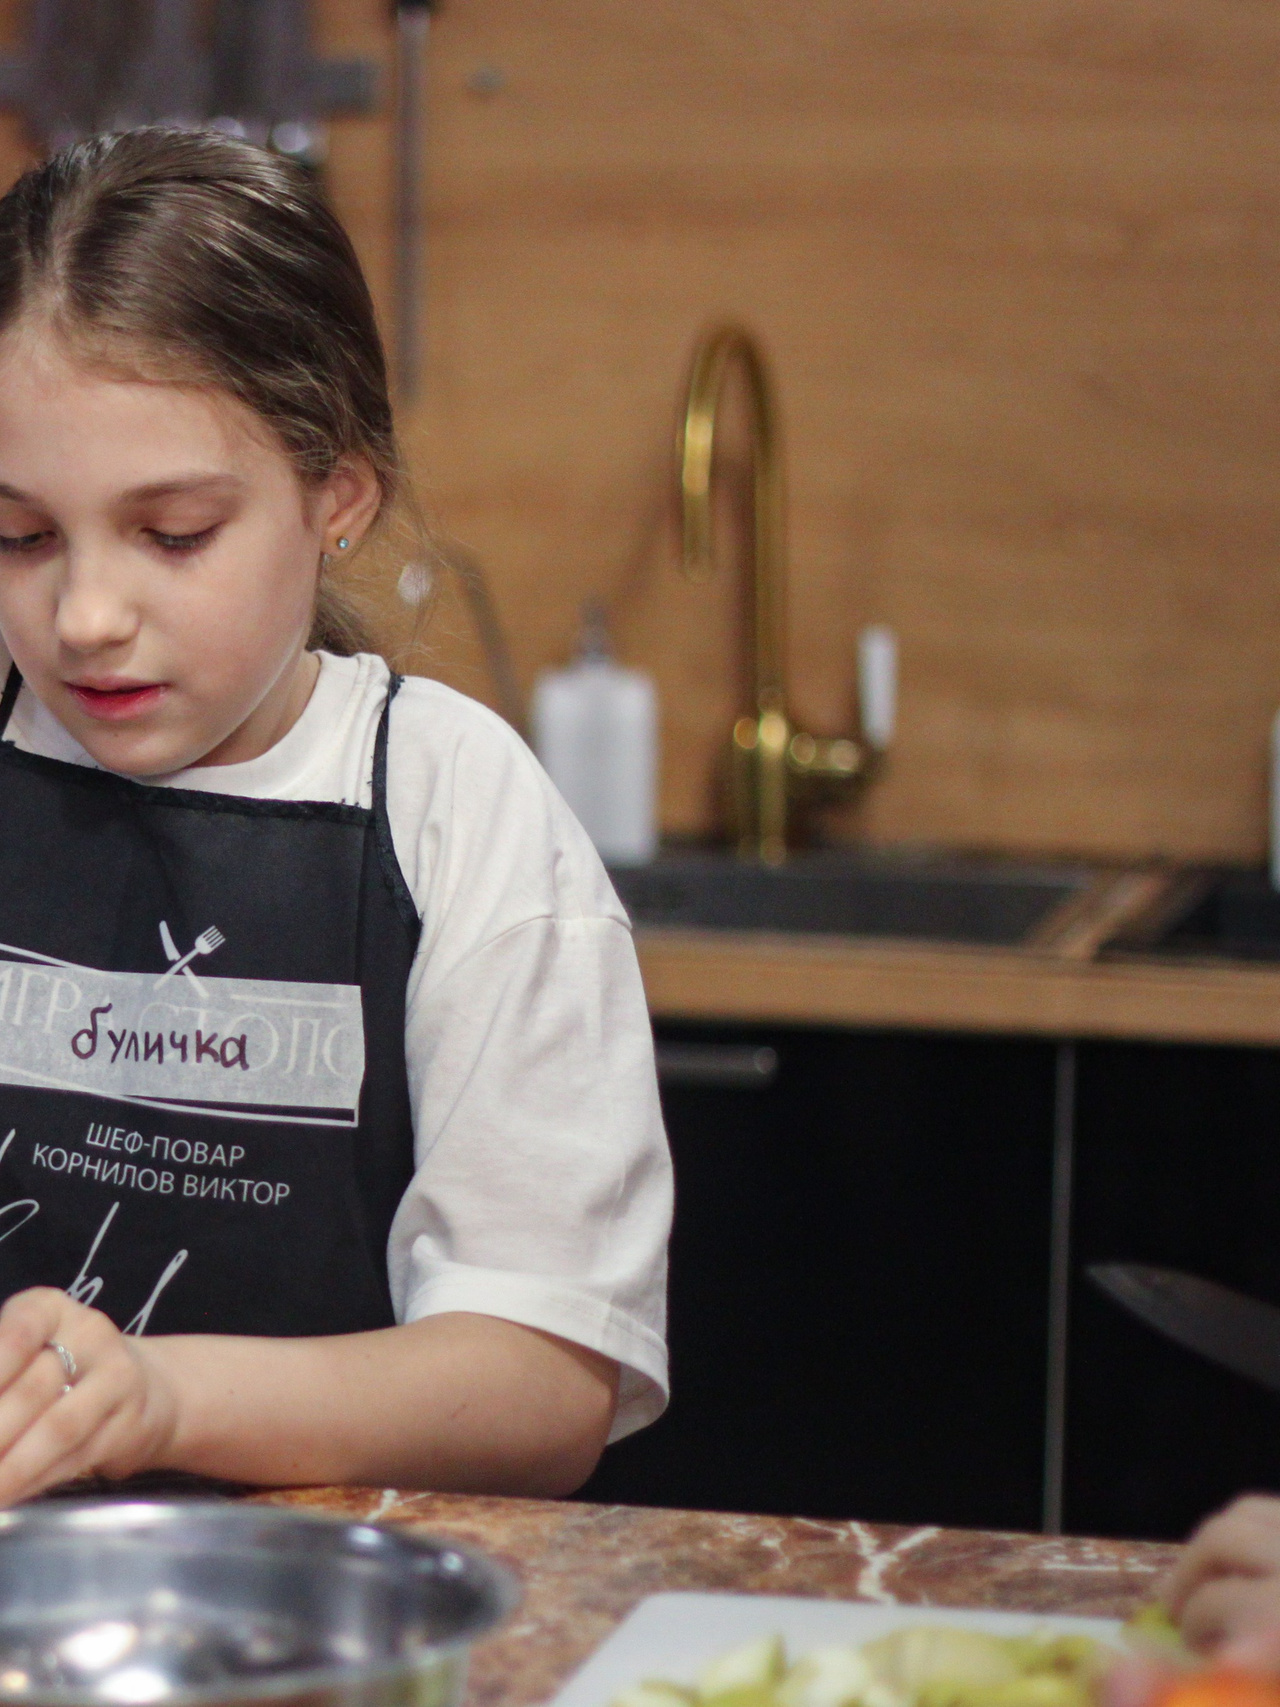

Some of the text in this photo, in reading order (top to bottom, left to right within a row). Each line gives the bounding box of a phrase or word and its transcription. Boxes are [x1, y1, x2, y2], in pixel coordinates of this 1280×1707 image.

[71, 1002, 250, 1071] буличка
[32, 1143, 291, 1206] КОРНИЛОВ ВИКТОР
[85, 1122, 246, 1167] ШЕФ-ПОВАР
